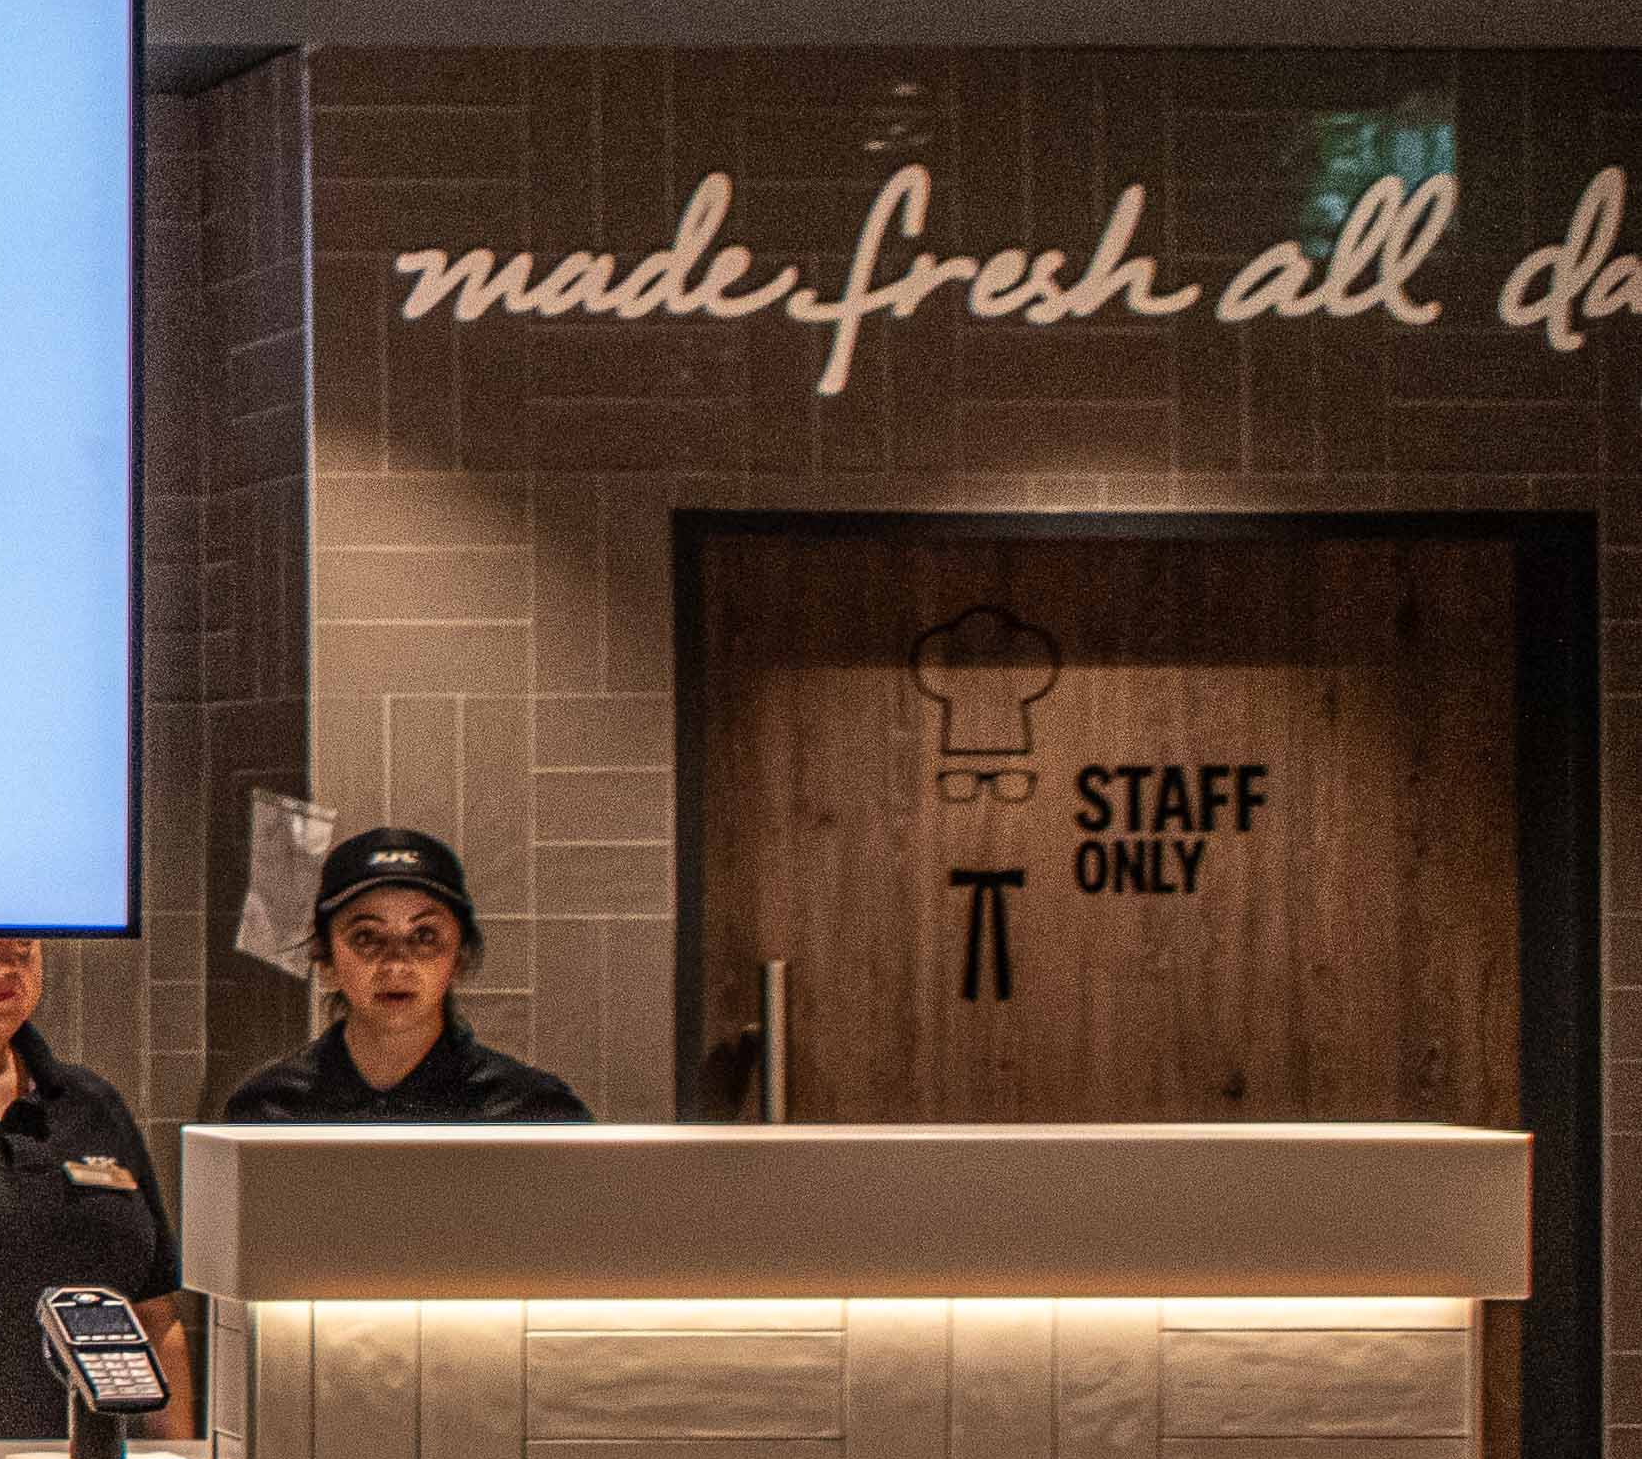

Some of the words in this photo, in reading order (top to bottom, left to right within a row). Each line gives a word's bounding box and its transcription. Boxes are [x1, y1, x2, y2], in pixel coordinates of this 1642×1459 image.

[395, 170, 796, 321] made
[786, 162, 1202, 396] fresh
[1214, 171, 1459, 326] all
[1076, 764, 1269, 834] STAFF
[1076, 840, 1206, 895] ONLY
